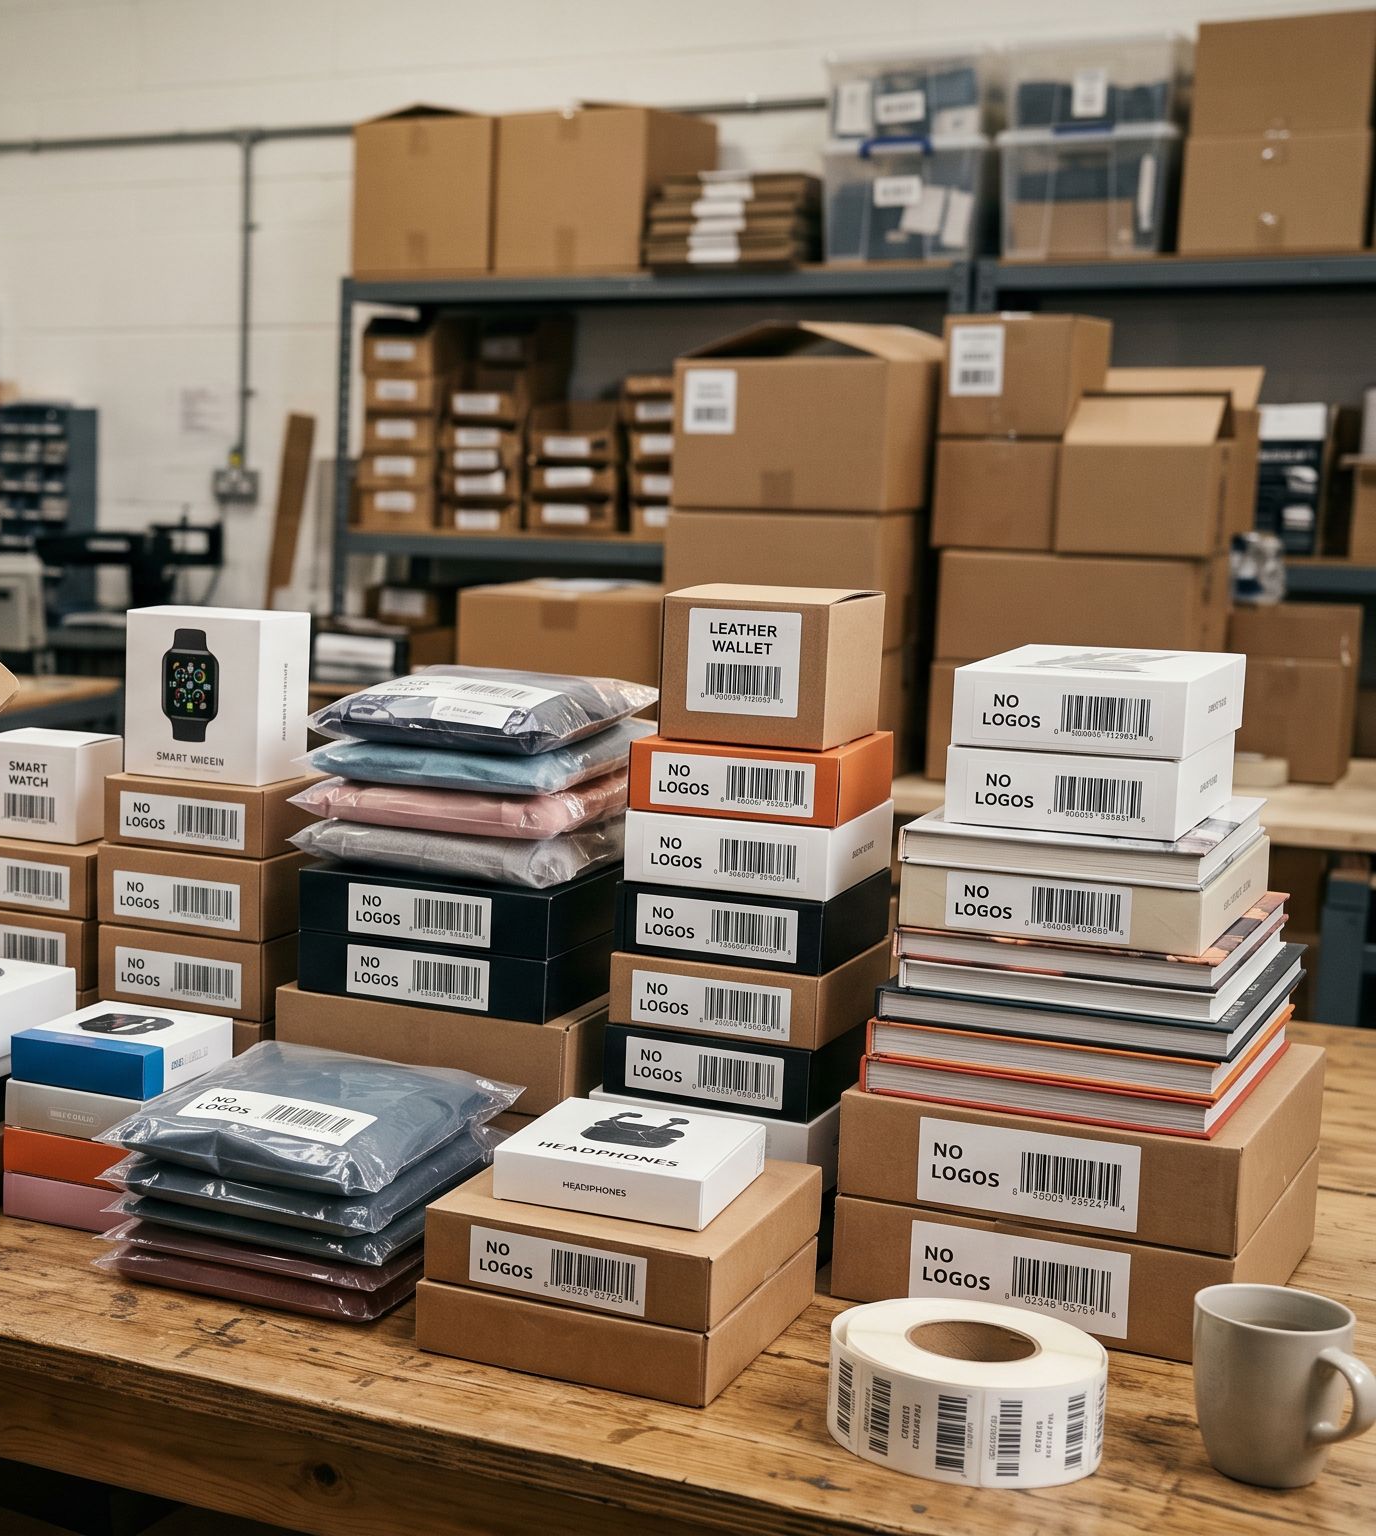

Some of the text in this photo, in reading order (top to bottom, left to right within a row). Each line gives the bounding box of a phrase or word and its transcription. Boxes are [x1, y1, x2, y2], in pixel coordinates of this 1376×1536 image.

[709, 622, 777, 638] LEATHER
[712, 640, 773, 655] WALLET
[993, 694, 1019, 708] NO
[982, 712, 1041, 728] LOGOS
[156, 751, 188, 763] SMART
[9, 760, 48, 774] SMART
[668, 764, 691, 777] NO
[8, 774, 49, 788] WATCH
[986, 772, 1012, 788] NO
[658, 780, 710, 796] LOGOS
[975, 792, 1034, 808] LOGOS
[133, 802, 150, 814] NO
[126, 816, 166, 830] LOGOS
[660, 836, 682, 850] NO
[650, 852, 702, 869] LOGOS
[126, 881, 144, 892] NO
[964, 884, 990, 898] NO
[120, 896, 160, 910] LOGOS
[362, 894, 382, 907] NO
[356, 910, 400, 926] LOGOS
[652, 906, 674, 920] NO
[955, 902, 1012, 920] LOGOS
[644, 922, 695, 939] LOGOS
[128, 958, 145, 970] NO
[360, 956, 380, 968] NO
[121, 972, 160, 987] LOGOS
[354, 971, 399, 988] LOGOS
[646, 982, 668, 996] NO
[640, 998, 689, 1016] LOGOS
[640, 1048, 662, 1062] NO
[633, 1064, 682, 1083] LOGOS
[212, 1096, 237, 1104] NO
[196, 1103, 252, 1115] LOGOS
[538, 1141, 680, 1167] HEADPHONES
[933, 1142, 963, 1160] NO
[932, 1164, 1000, 1188] LOGOS
[486, 1240, 510, 1256] NO
[924, 1245, 954, 1263] NO
[479, 1258, 533, 1280] LOGOS
[922, 1266, 990, 1291] LOGOS
